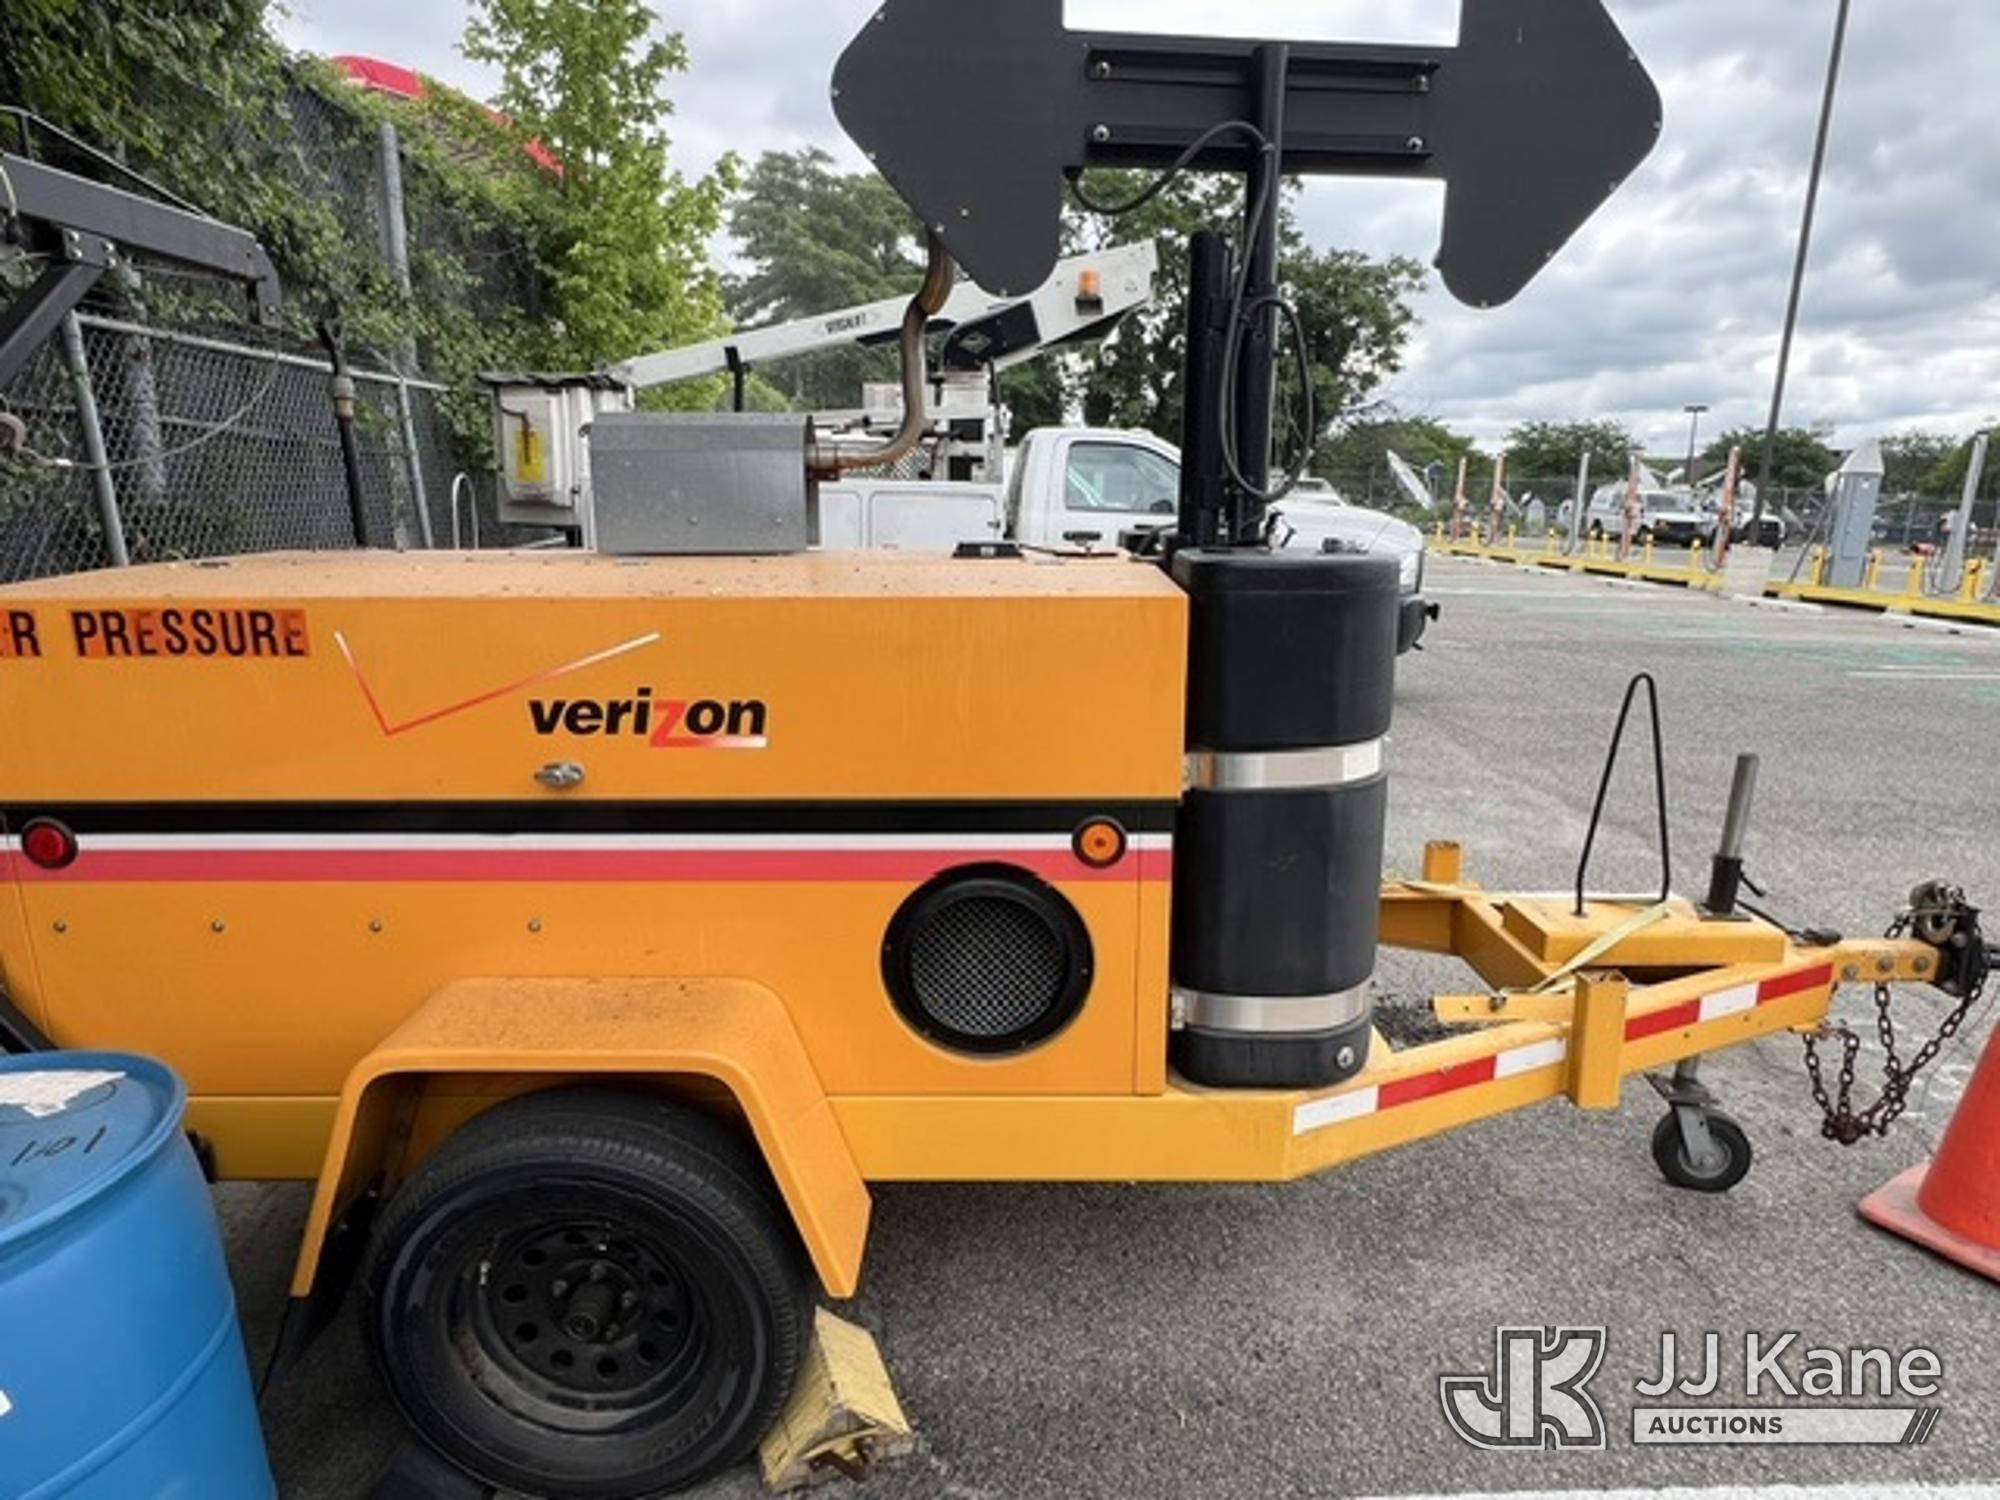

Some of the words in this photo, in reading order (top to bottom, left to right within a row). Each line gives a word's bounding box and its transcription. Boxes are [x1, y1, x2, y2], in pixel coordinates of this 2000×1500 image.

[0, 610, 41, 657] R
[71, 609, 308, 657] PRESSURE
[529, 687, 767, 748] verizon
